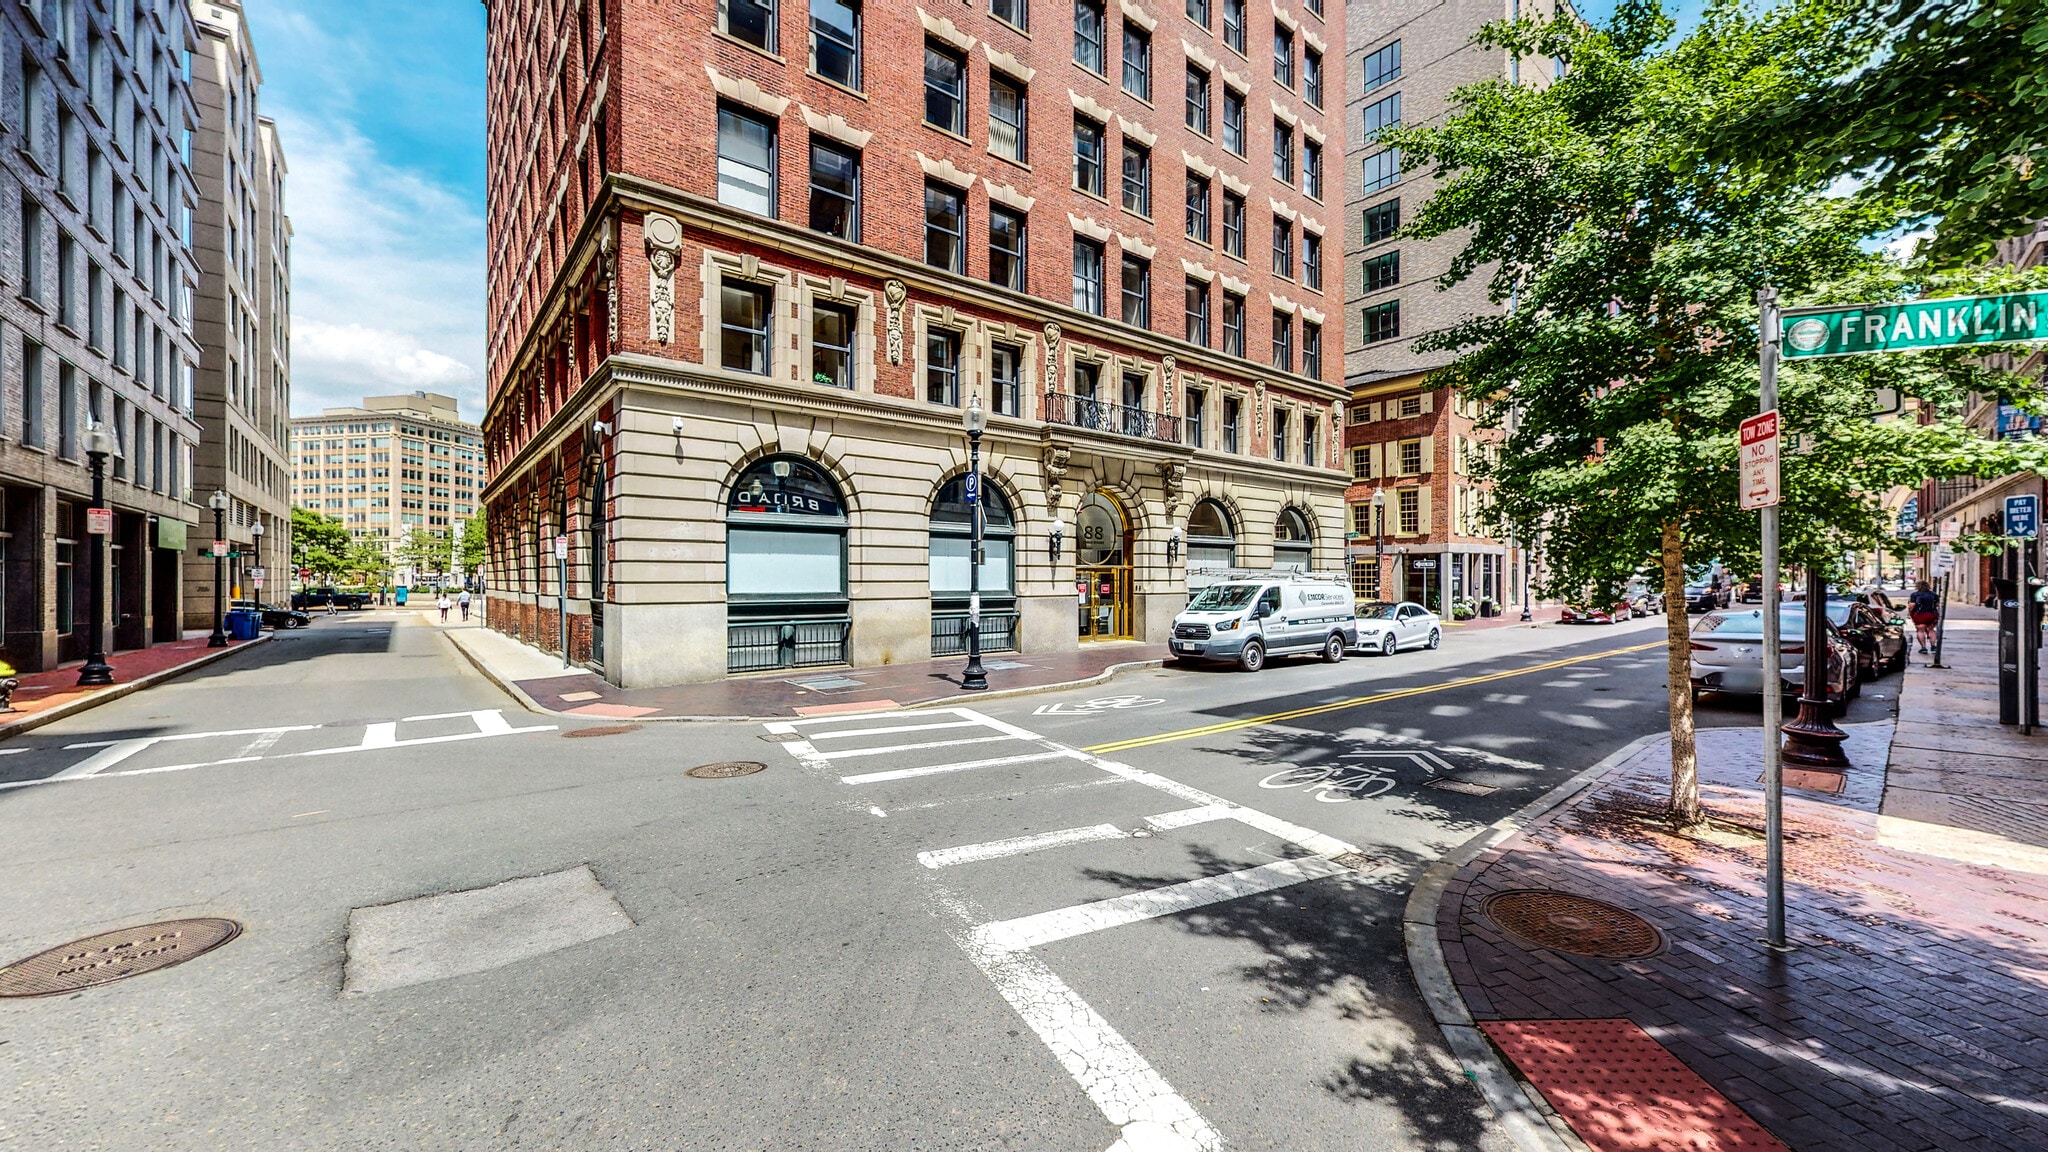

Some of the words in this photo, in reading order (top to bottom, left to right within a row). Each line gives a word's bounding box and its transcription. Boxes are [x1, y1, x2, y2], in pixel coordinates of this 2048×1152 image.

[1841, 301, 2036, 346] FRANKLIN
[1742, 425, 1756, 441] TOW
[1757, 419, 1775, 437] ZONE
[1751, 443, 1766, 457] NO
[1744, 455, 1774, 470] STOPPING
[1753, 468, 1765, 476] ANY
[1752, 477, 1767, 487] TIME
[2009, 506, 2032, 514] METER
[1084, 525, 1104, 540] 88
